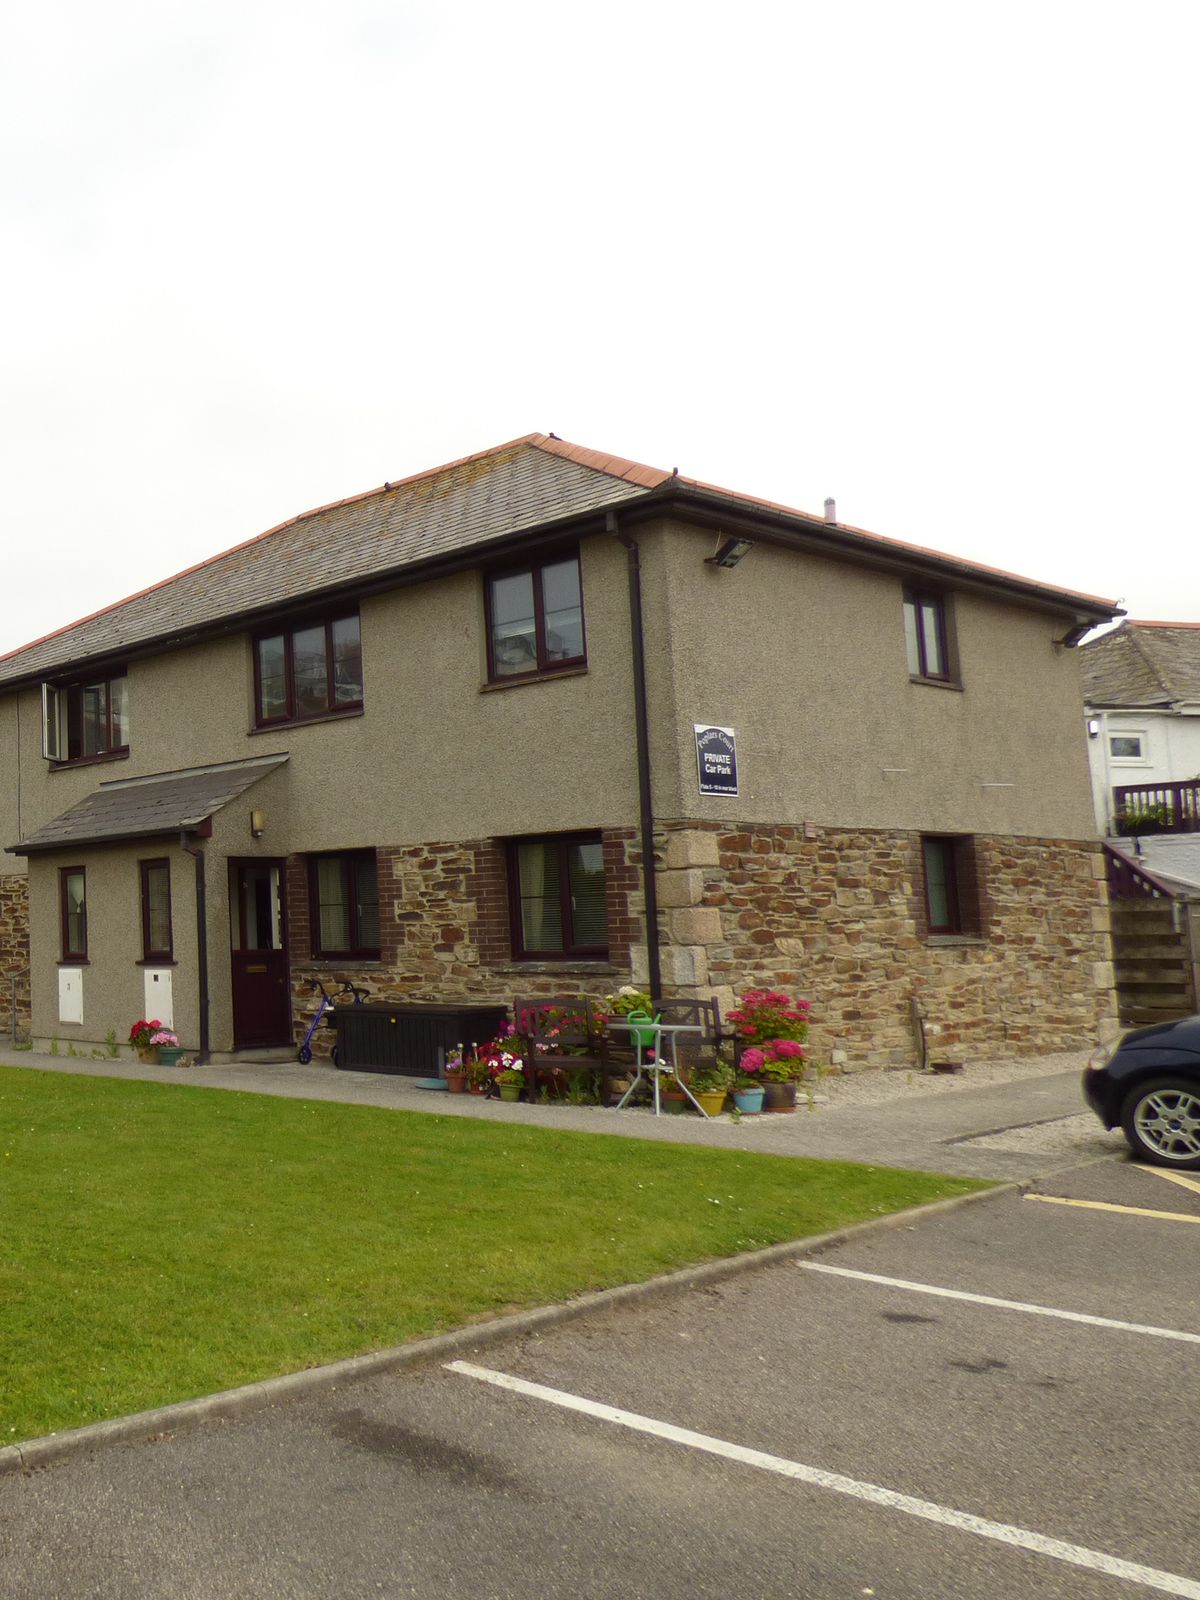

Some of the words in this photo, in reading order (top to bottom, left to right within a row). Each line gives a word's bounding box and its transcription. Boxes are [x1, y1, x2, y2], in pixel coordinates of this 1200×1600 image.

[718, 731, 734, 752] Court
[704, 753, 731, 764] PRIVATE
[705, 764, 716, 773] Car
[717, 765, 731, 775] Park
